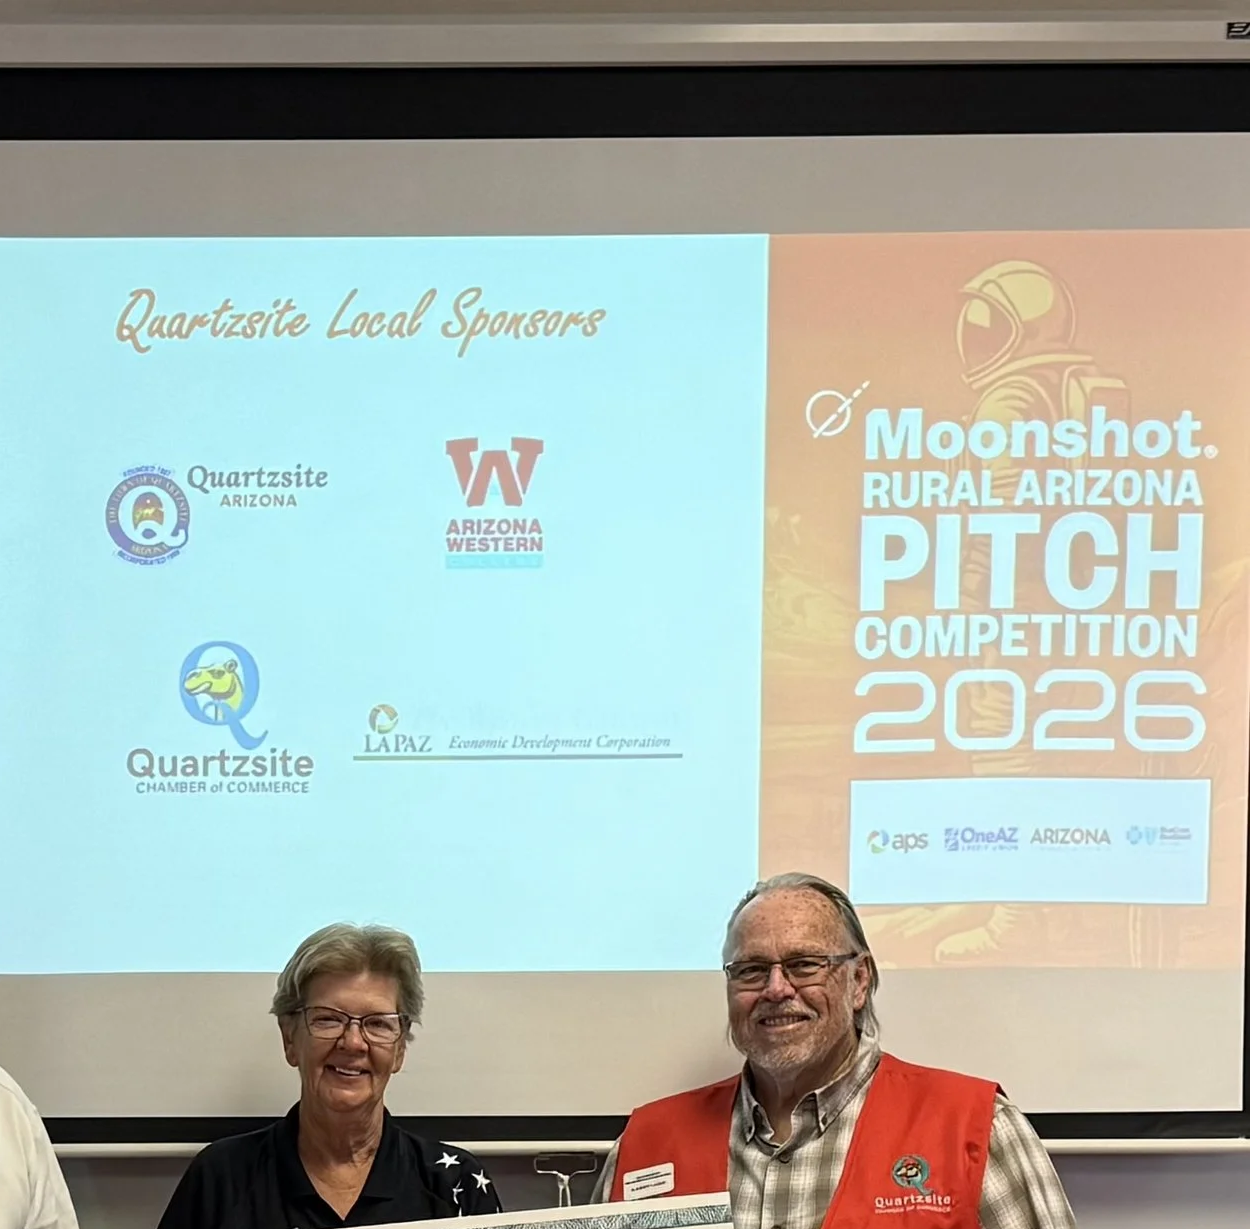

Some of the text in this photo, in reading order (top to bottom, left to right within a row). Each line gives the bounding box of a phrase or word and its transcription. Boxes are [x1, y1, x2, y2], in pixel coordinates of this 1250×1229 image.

[116, 287, 607, 358] Quartzsite Local Sponsors
[865, 406, 1202, 460] Moonshot
[187, 464, 328, 494] Quartzsite
[863, 469, 1204, 508] RURAL ARIZONA
[220, 494, 297, 507] ARIZONA
[446, 519, 542, 535] ARIZONA
[446, 537, 543, 552] WESTERN
[860, 511, 1204, 612] PITCH
[855, 615, 1198, 659] COMPETITION
[854, 669, 1207, 753] 2026
[395, 734, 432, 753] PAZ
[449, 736, 508, 749] Economic
[512, 735, 592, 751] Development
[597, 735, 670, 752] Corporation
[127, 748, 314, 779] Quartzsite
[136, 781, 309, 793] CHAMBER of COMMERCE
[892, 831, 928, 853] aps
[961, 827, 1018, 843] OneAZ
[1030, 828, 1111, 845] ARIZONA
